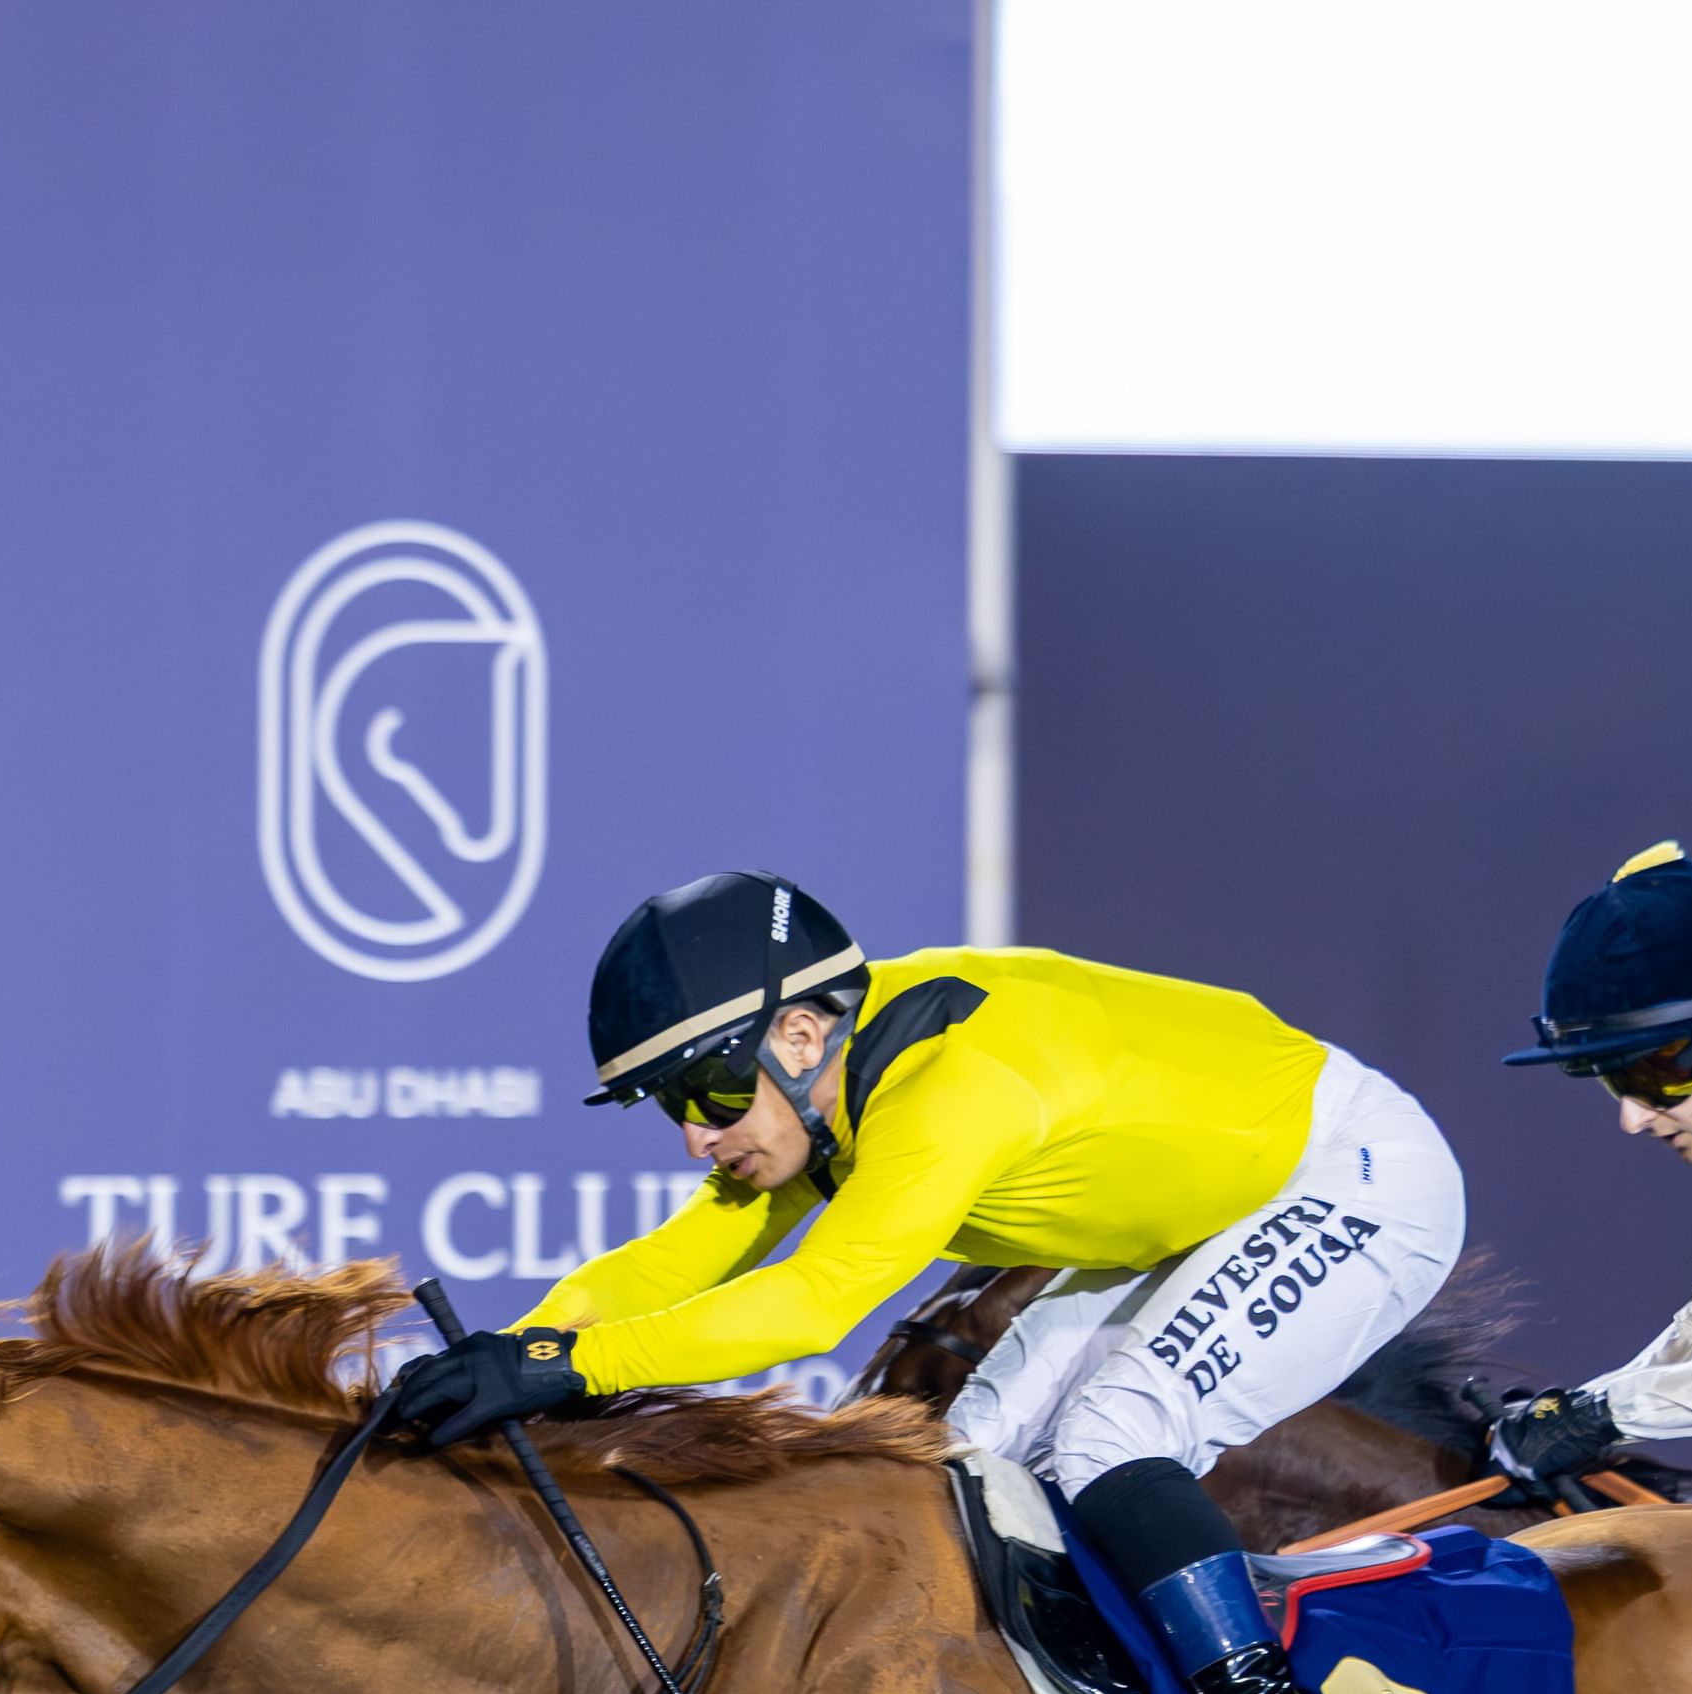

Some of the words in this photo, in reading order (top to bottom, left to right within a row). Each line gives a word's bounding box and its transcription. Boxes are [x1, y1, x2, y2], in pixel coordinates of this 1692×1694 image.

[270, 1066, 378, 1118] ABU
[386, 1066, 541, 1118] DHABI
[1185, 1334, 1242, 1403] DE
[1248, 1215, 1381, 1339] SOUSA
